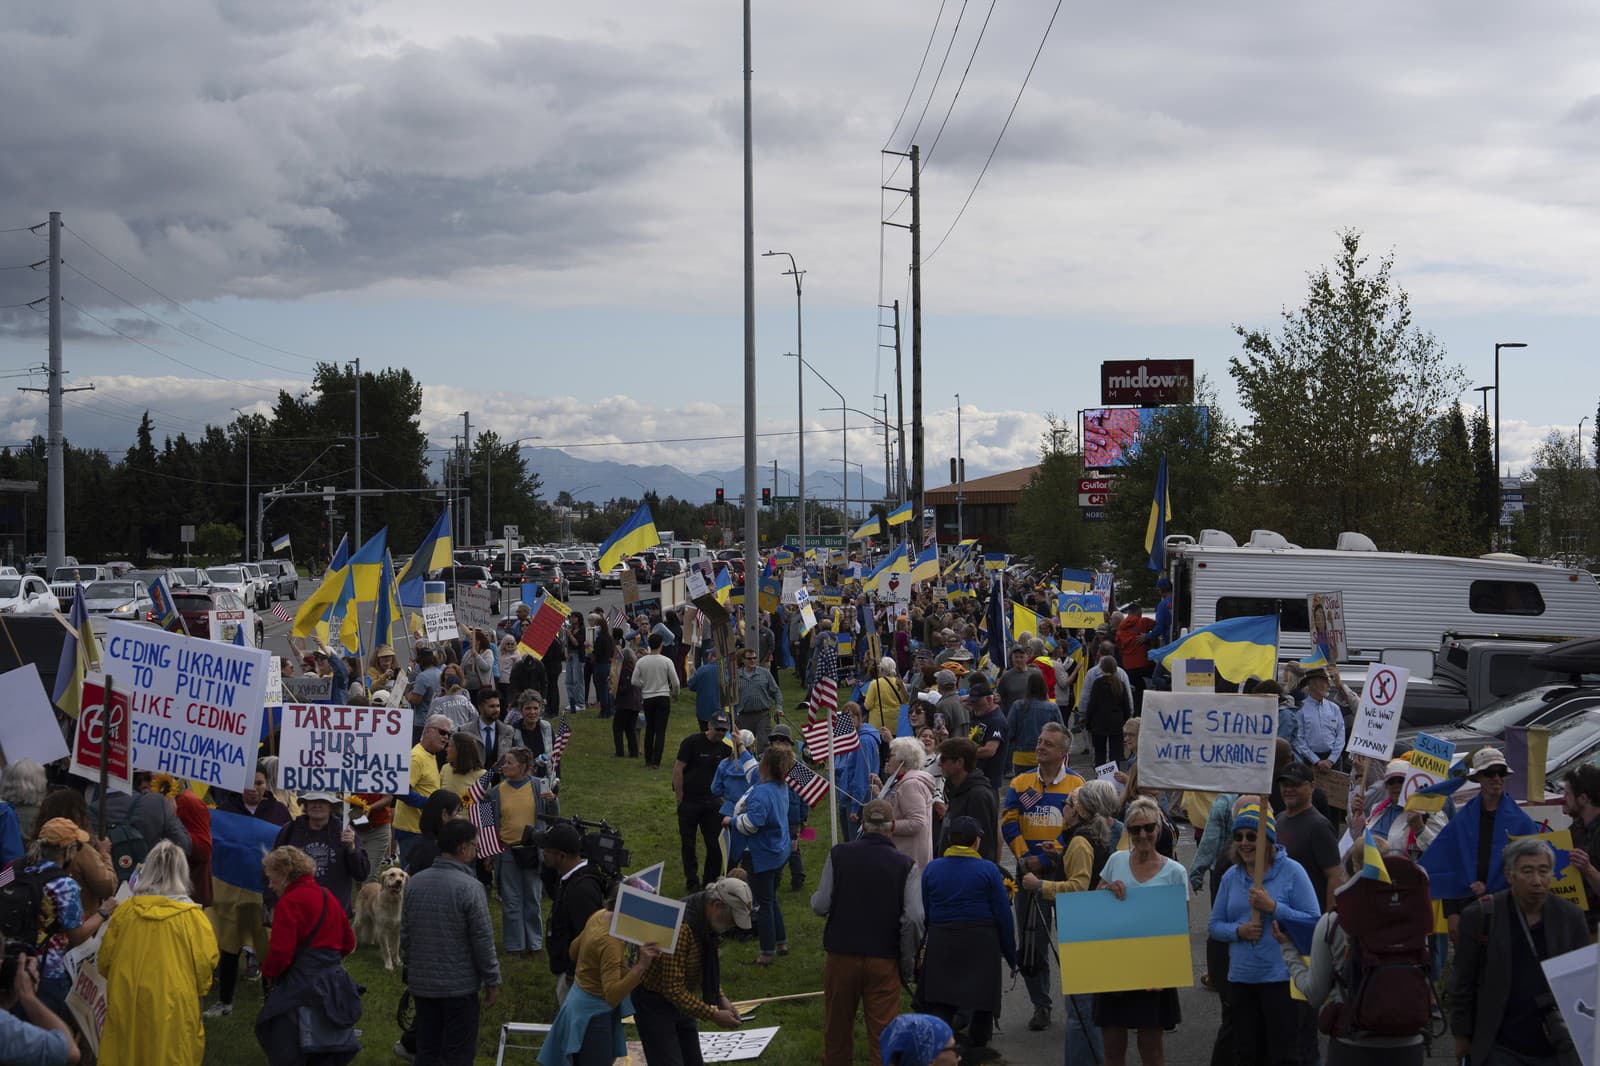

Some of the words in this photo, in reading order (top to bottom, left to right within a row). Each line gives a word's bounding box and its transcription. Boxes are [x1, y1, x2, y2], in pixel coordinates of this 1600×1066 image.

[1108, 365, 1189, 388] midtown
[1081, 481, 1107, 490] Guitar
[110, 637, 171, 669] CEDING
[177, 649, 254, 687] UKRAINE
[132, 664, 153, 689] TO
[175, 673, 236, 707] PUTIN
[132, 691, 174, 719] LIKE
[186, 703, 247, 736] CEDING
[289, 705, 401, 735] TARIFFS
[1158, 709, 1192, 735] WE
[1206, 710, 1273, 735] STAND
[1364, 707, 1377, 718] WE
[310, 731, 373, 754] HURT
[1155, 743, 1191, 761] WITH
[1200, 744, 1269, 765] UKRAINE
[1419, 738, 1449, 759] SLAVA
[158, 750, 222, 785] HITLER
[342, 752, 409, 772] SMALL
[283, 766, 399, 794] BUSINESS
[1034, 805, 1051, 815] THE
[75, 970, 98, 1007] PEDO
